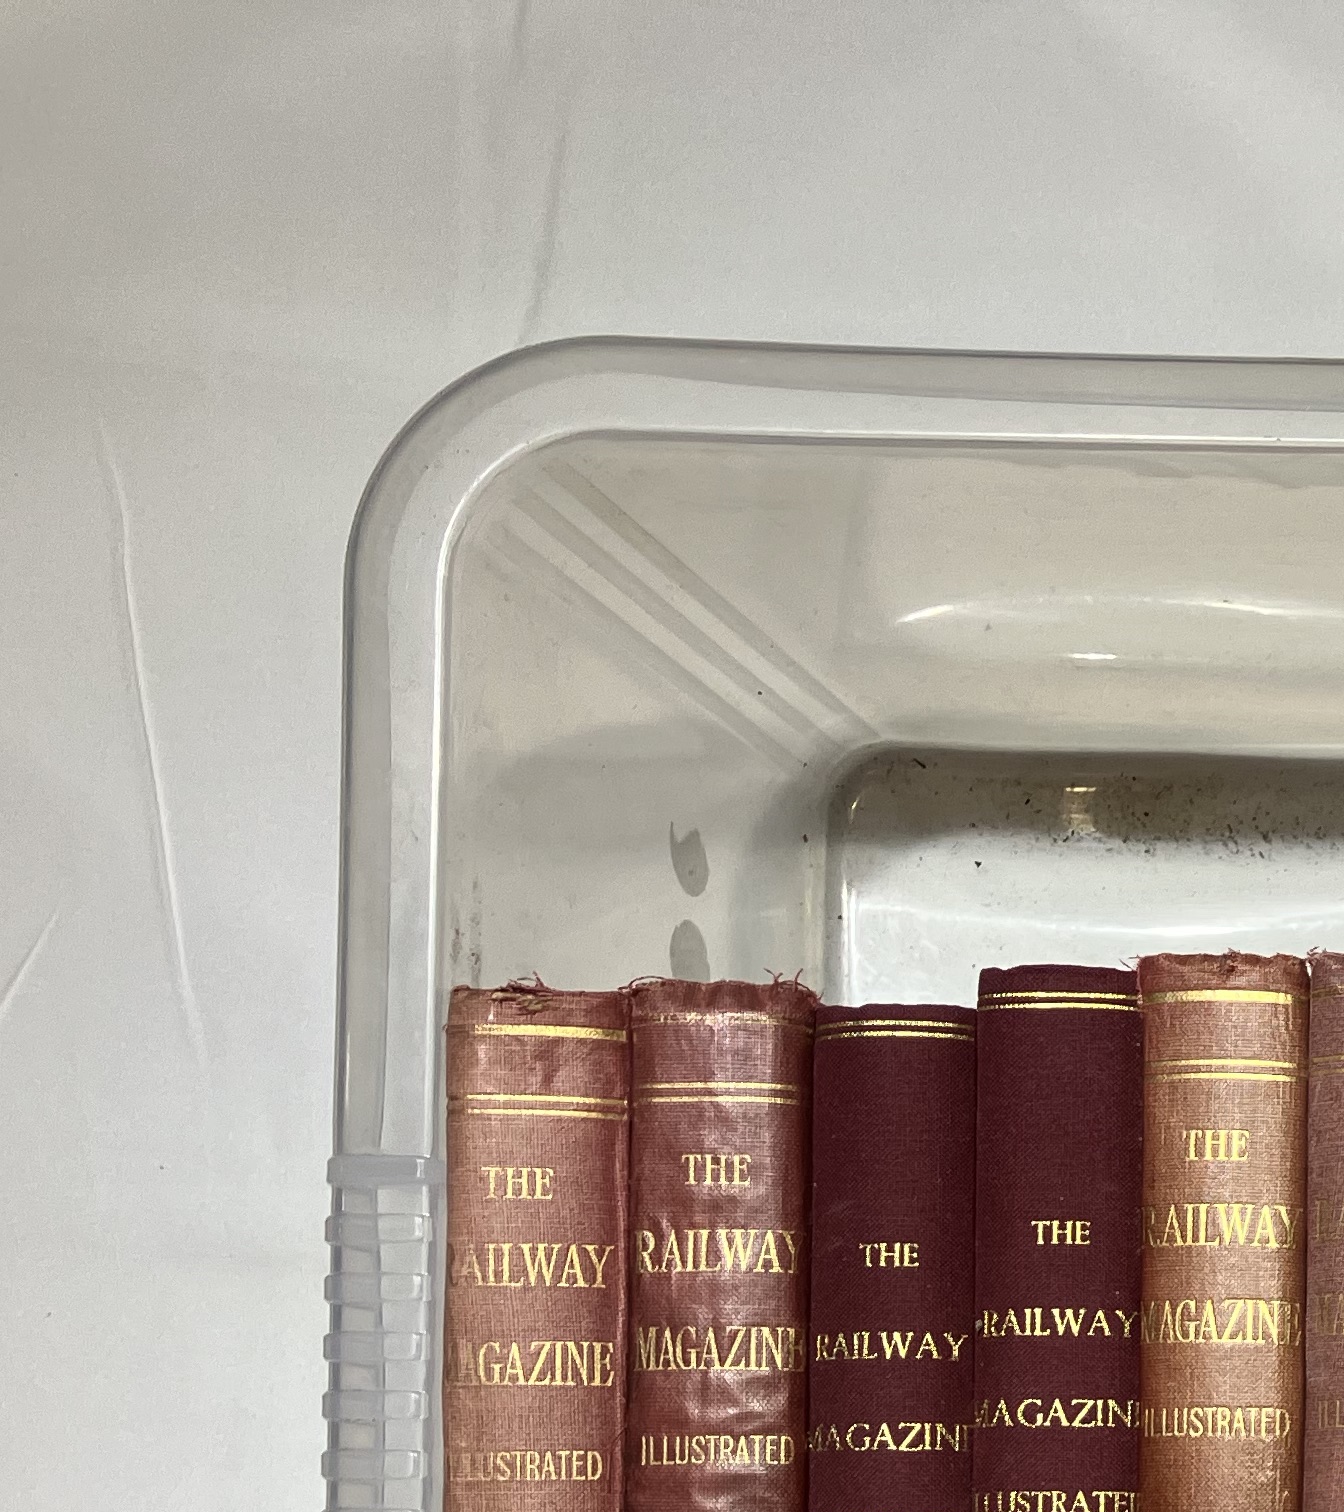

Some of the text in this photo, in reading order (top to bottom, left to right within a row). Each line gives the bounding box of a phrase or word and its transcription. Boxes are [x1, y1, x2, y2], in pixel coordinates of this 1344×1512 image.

[1183, 1128, 1251, 1163] THE
[481, 1166, 554, 1200] THE
[682, 1154, 752, 1187] THE
[1031, 1219, 1091, 1246] THE
[1142, 1202, 1303, 1250] RAILWAY
[635, 1229, 803, 1275] RAILWAY
[860, 1242, 920, 1268] THE
[981, 1307, 1140, 1339] RAILWAY
[1140, 1297, 1301, 1347] MAGAZINE
[634, 1326, 804, 1373] MAGAZINE
[815, 1331, 969, 1362] RAILWAY
[1144, 1407, 1291, 1440] ILLUSTRATED
[640, 1435, 796, 1467] ILLUSTRATED
